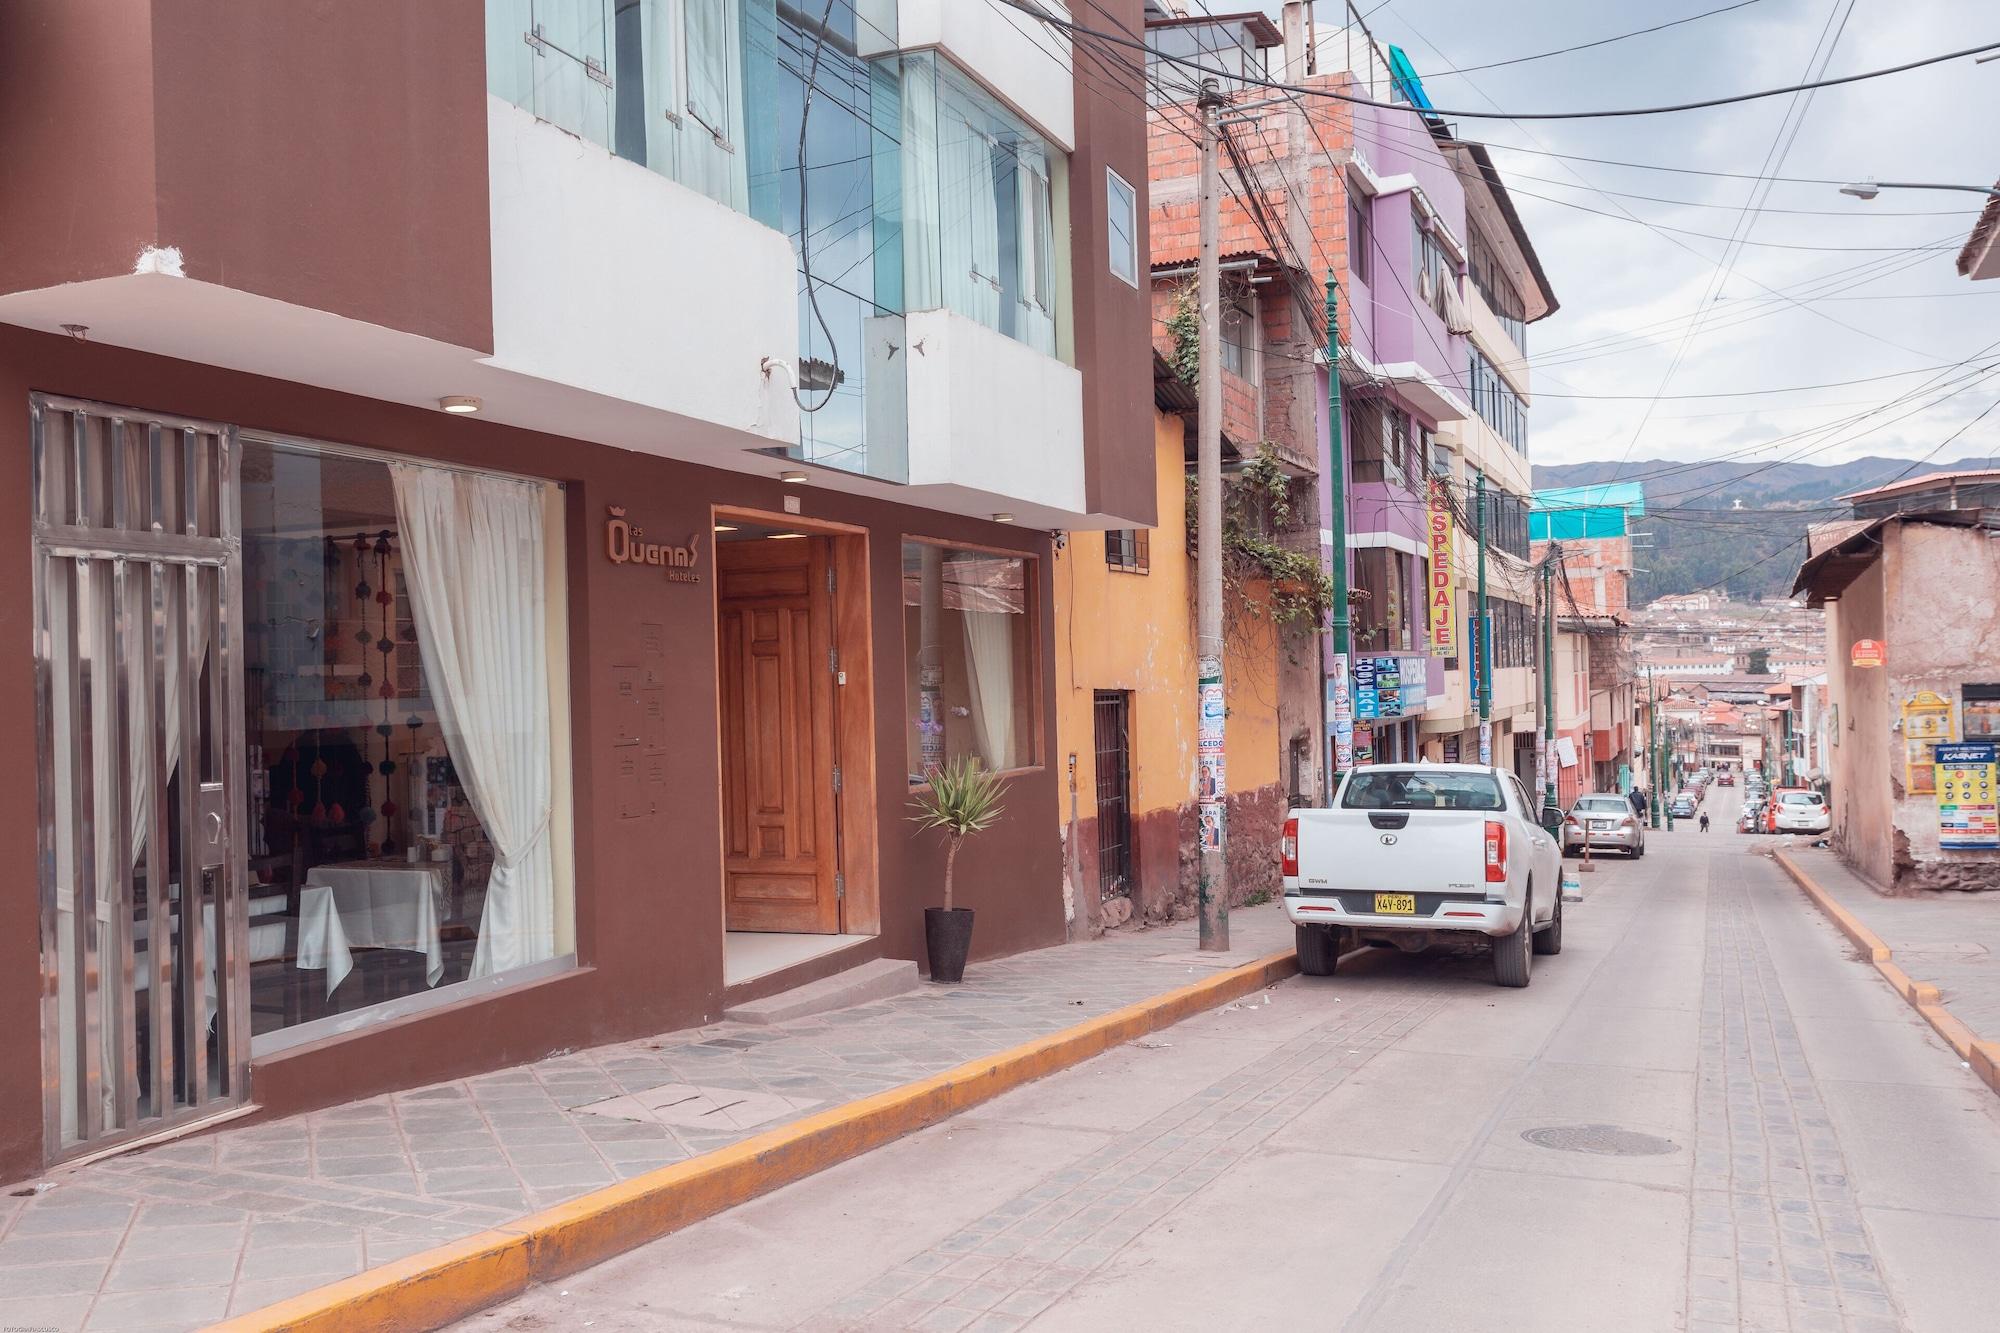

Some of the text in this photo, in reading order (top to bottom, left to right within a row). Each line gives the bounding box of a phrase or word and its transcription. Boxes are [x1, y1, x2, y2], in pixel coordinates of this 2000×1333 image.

[629, 524, 644, 537] las
[669, 570, 701, 584] Hoteles
[1943, 752, 1987, 761] KASNET
[1377, 899, 1413, 911] X4Y-891
